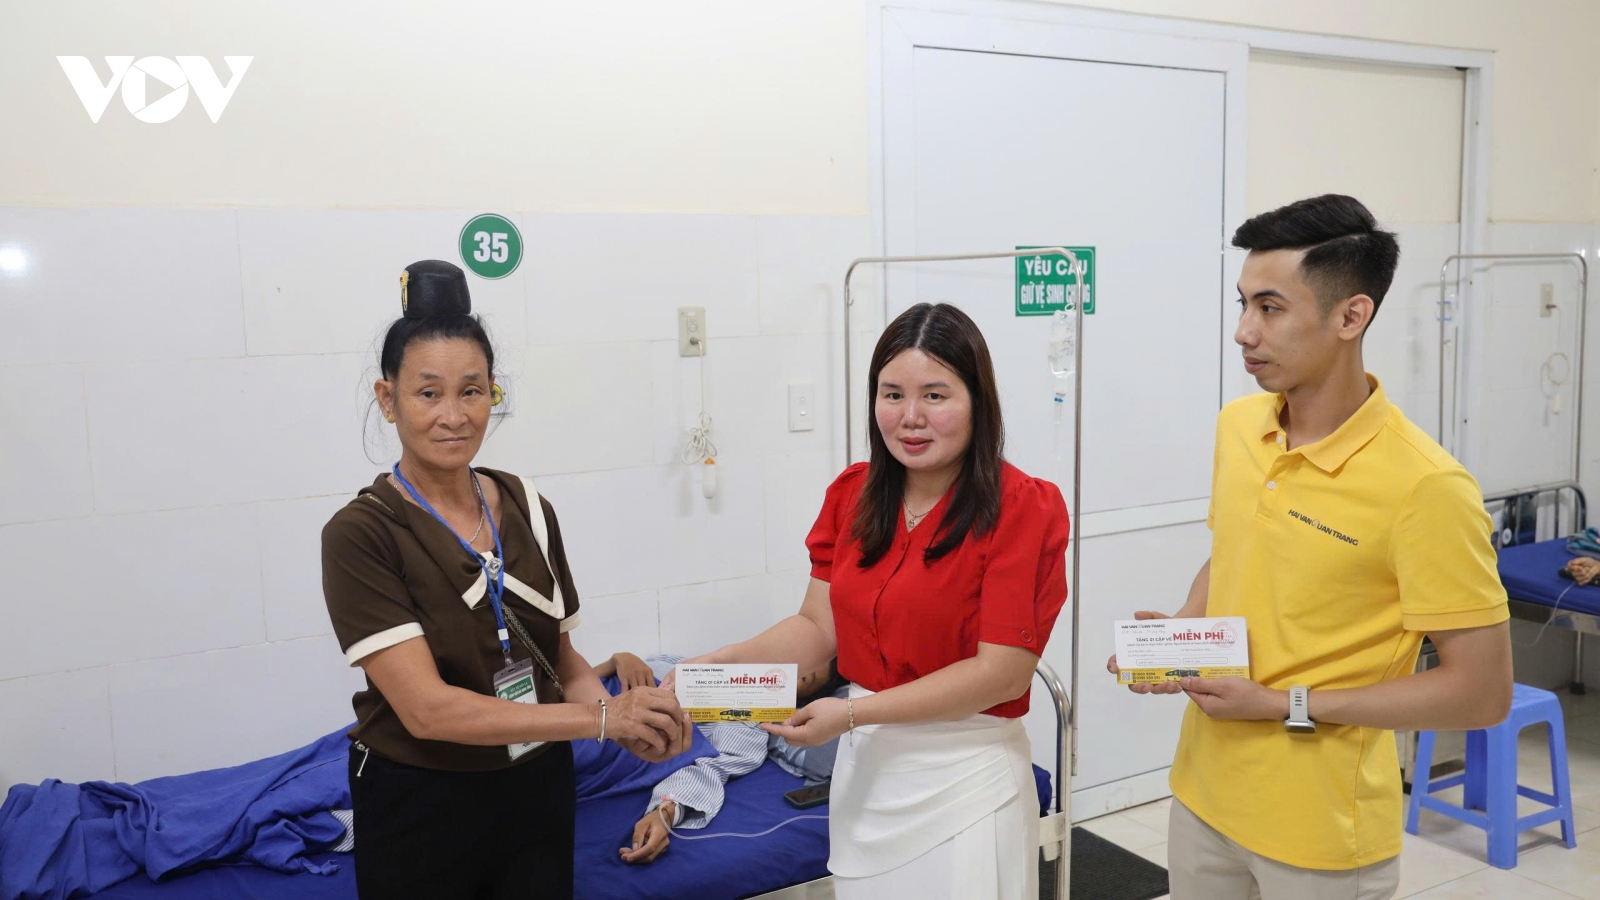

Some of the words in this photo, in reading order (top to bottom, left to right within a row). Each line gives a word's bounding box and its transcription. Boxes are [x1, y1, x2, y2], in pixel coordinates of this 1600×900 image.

[474, 231, 508, 263] 35
[1025, 255, 1052, 276] YÊU
[1035, 280, 1045, 308] VỆ
[1046, 284, 1065, 304] SINH
[1066, 283, 1091, 304] CHG
[1288, 509, 1300, 519] HAI
[1300, 514, 1312, 525] VAN
[1333, 530, 1359, 546] TRANG
[1173, 629, 1201, 641] MIỄN
[1205, 629, 1224, 640] PHÍ
[730, 674, 756, 685] MIỄN
[759, 675, 777, 684] PHÍ
